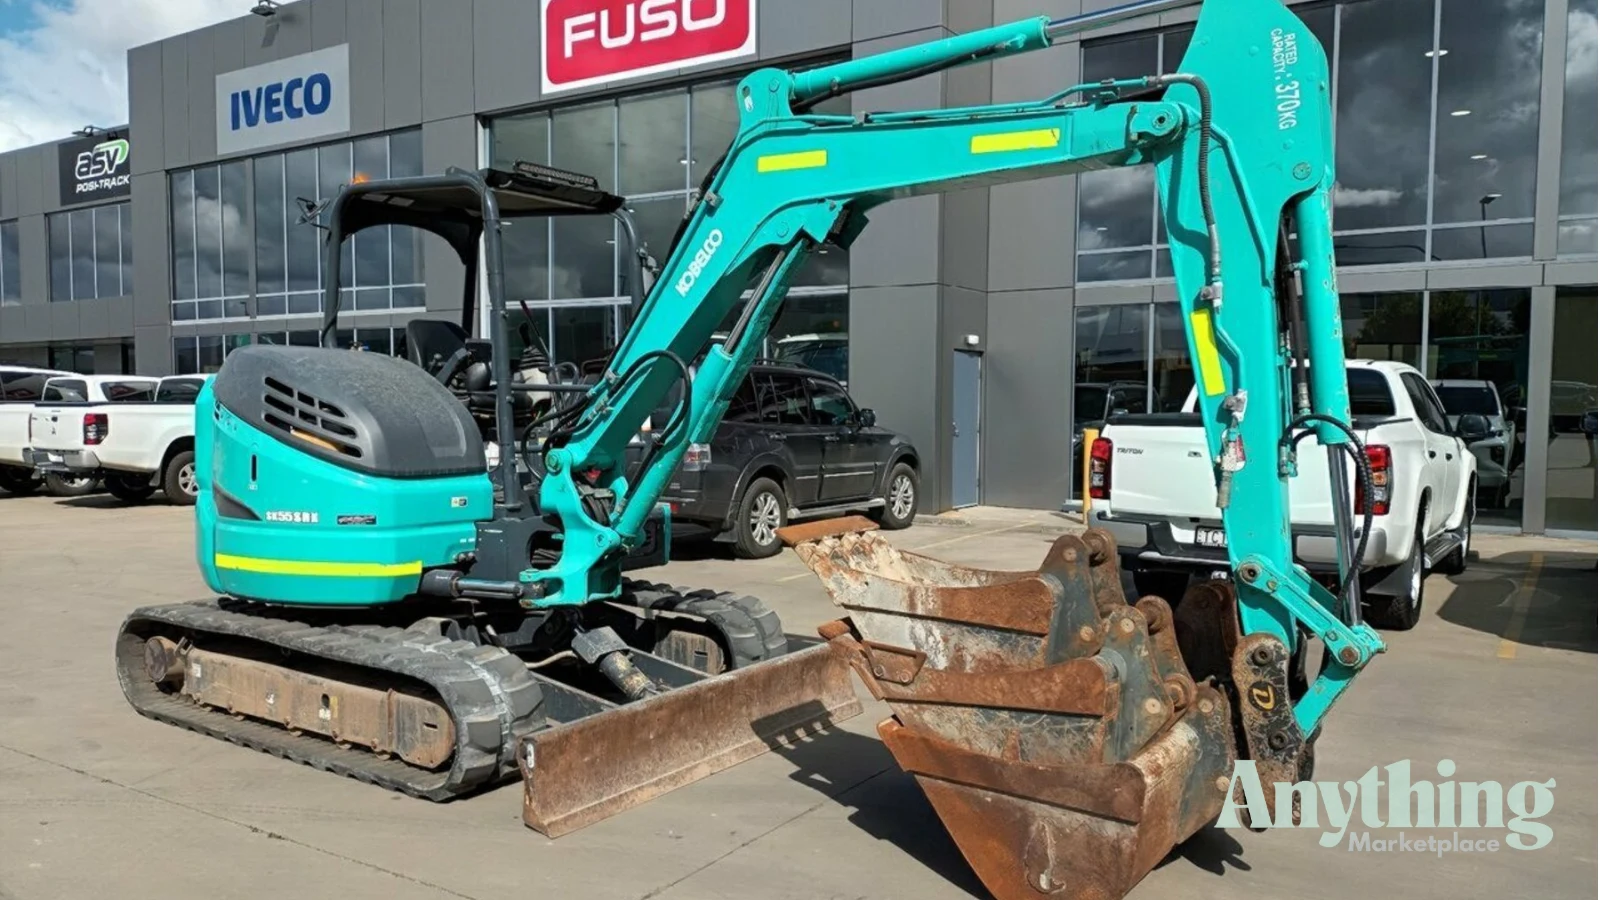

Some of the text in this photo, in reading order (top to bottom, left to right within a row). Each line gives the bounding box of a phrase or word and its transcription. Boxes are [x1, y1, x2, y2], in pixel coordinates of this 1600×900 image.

[564, 0, 726, 58] FUSO
[1284, 32, 1298, 65] RATED
[231, 73, 331, 131] IVECO
[1275, 80, 1301, 130] 370KG
[76, 174, 131, 194] POSI-TRACK
[674, 228, 723, 298] KOBELCO
[1116, 447, 1144, 455] TRITON
